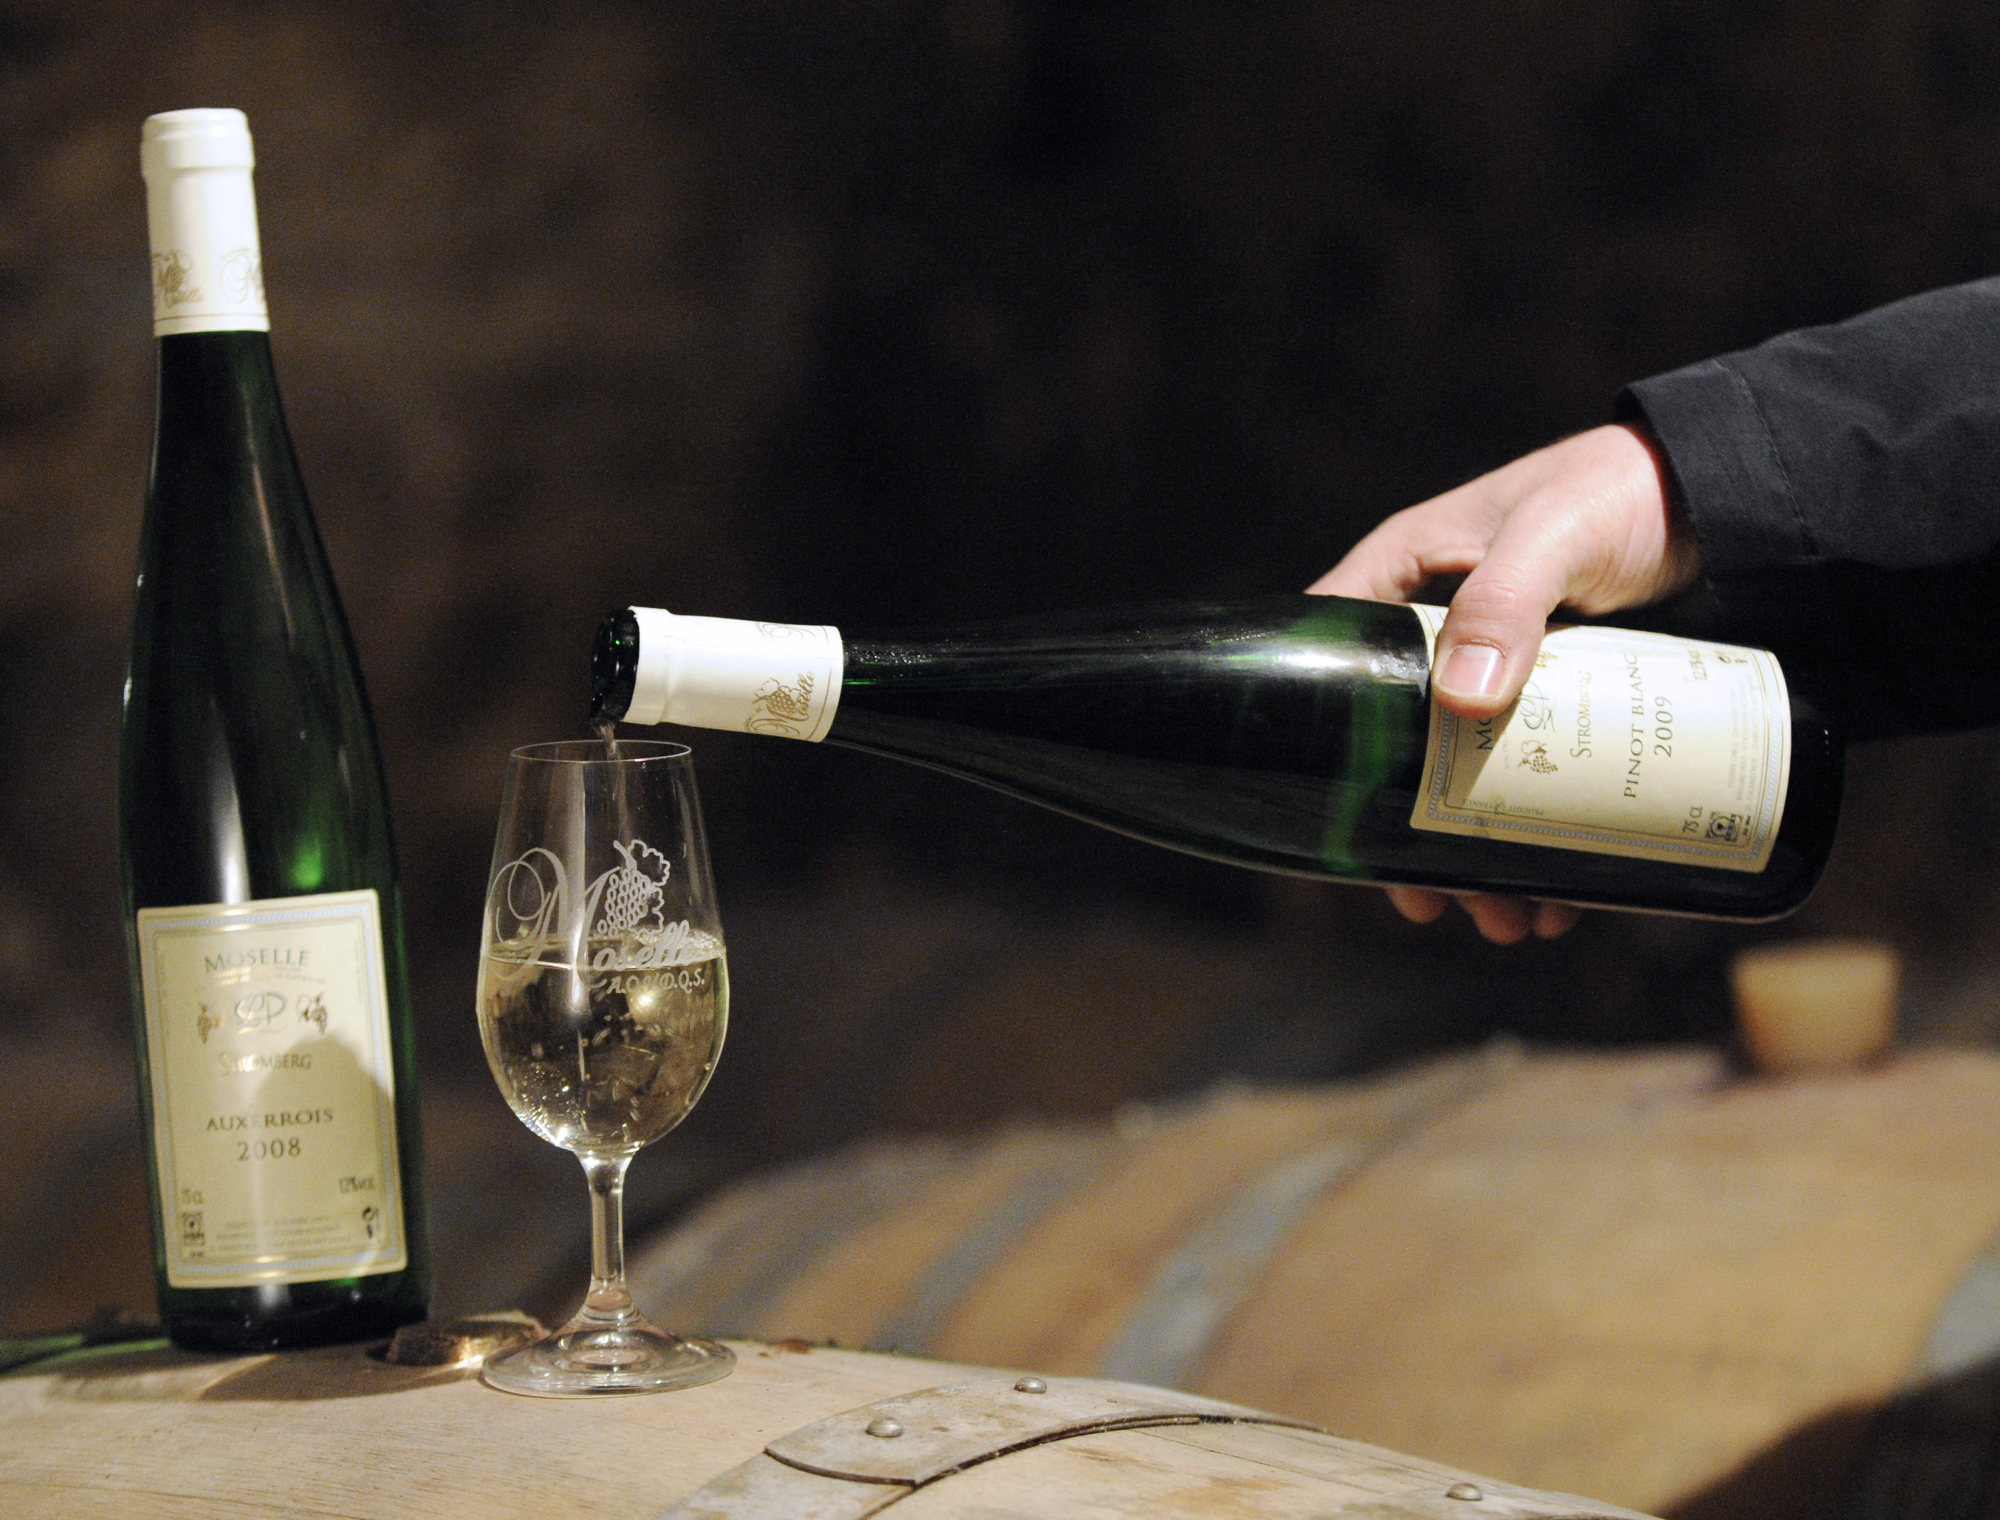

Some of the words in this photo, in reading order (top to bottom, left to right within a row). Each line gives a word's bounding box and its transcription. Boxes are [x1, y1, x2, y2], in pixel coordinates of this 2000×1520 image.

[1625, 652, 1645, 717] BLANC
[1654, 696, 1674, 758] 2009
[1624, 724, 1645, 799] PINOT
[205, 948, 309, 975] MOSELLE
[205, 1108, 334, 1132] AUXERROIS
[236, 1136, 302, 1161] 2008
